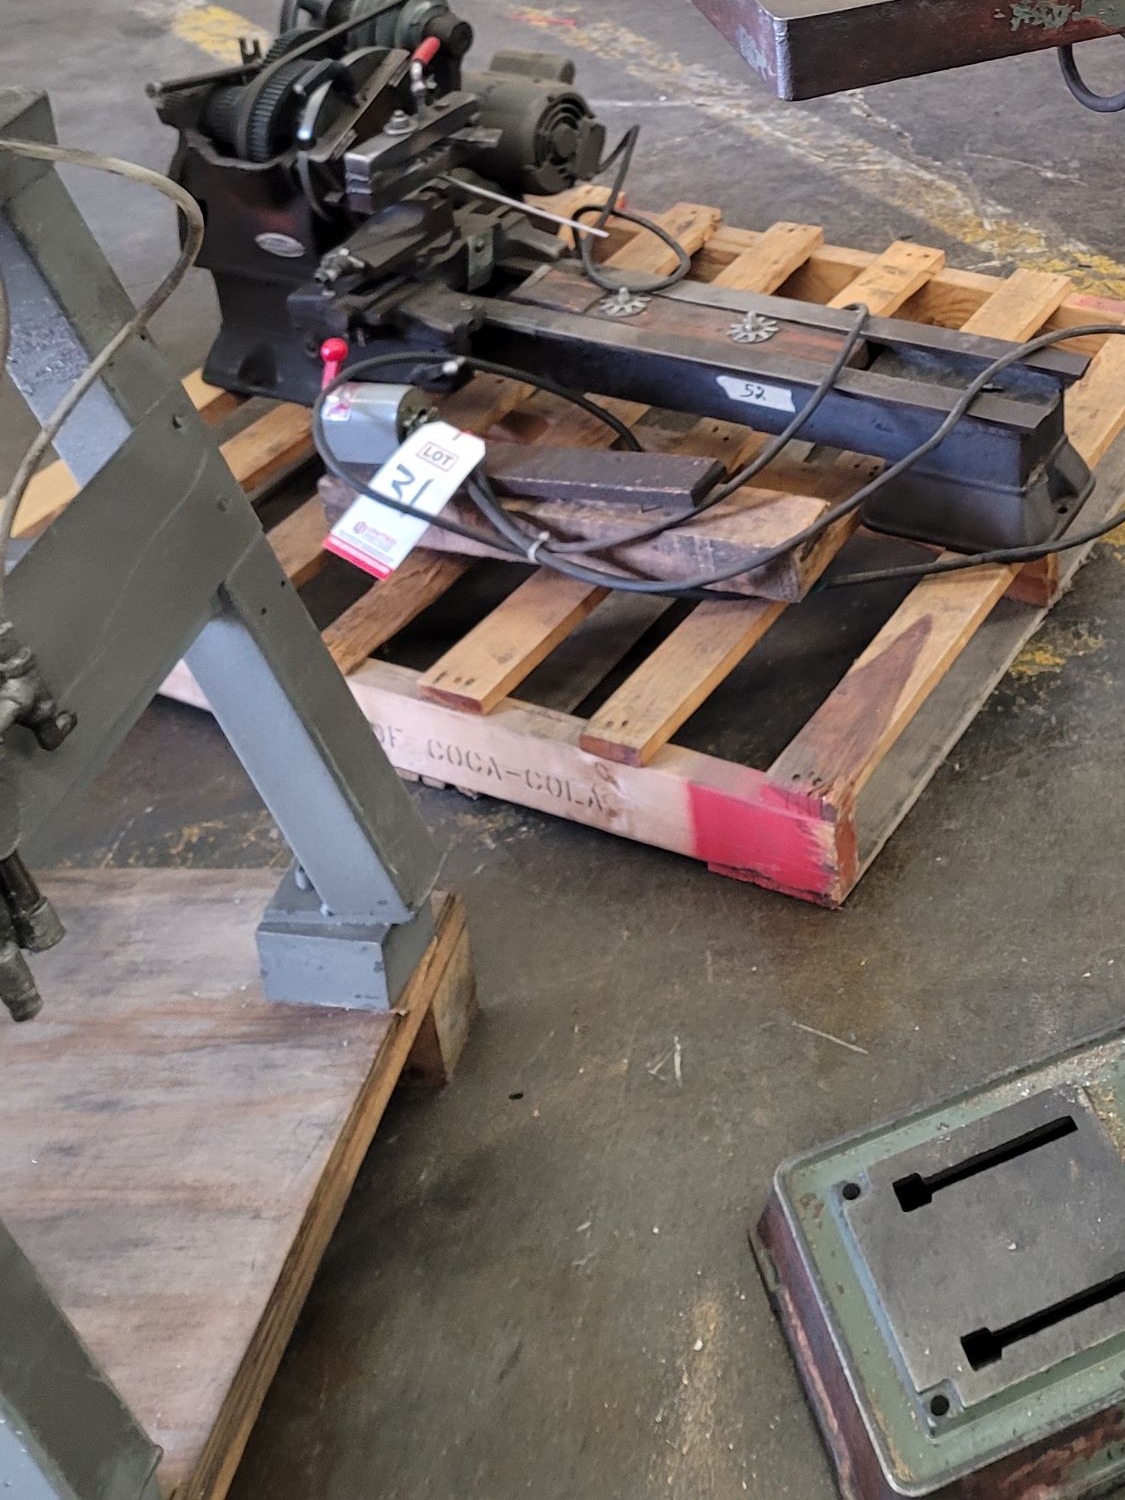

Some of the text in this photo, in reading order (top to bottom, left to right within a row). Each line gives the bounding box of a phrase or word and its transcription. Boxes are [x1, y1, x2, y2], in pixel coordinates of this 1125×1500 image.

[740, 383, 767, 402] 52
[423, 446, 454, 467] LOT
[427, 739, 604, 812] COCA-COLA
